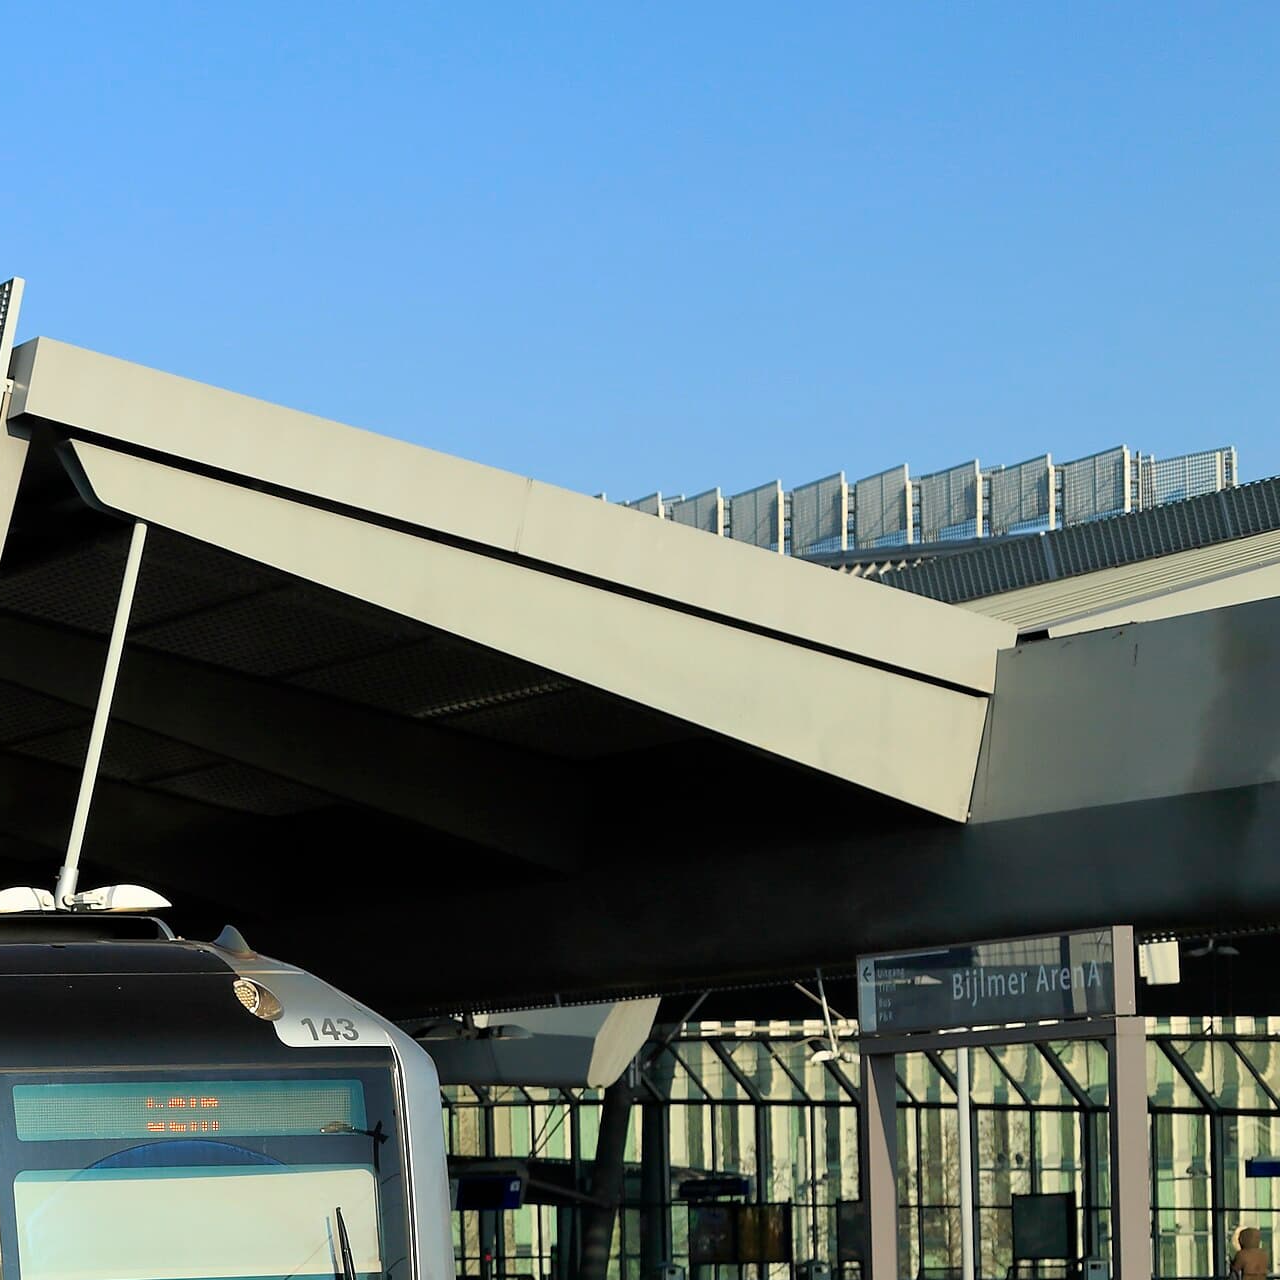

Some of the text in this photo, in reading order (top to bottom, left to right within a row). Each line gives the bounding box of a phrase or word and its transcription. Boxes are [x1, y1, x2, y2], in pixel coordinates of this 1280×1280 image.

[952, 959, 1102, 1008] Bijlmer ArenA
[300, 1017, 360, 1041] 143
